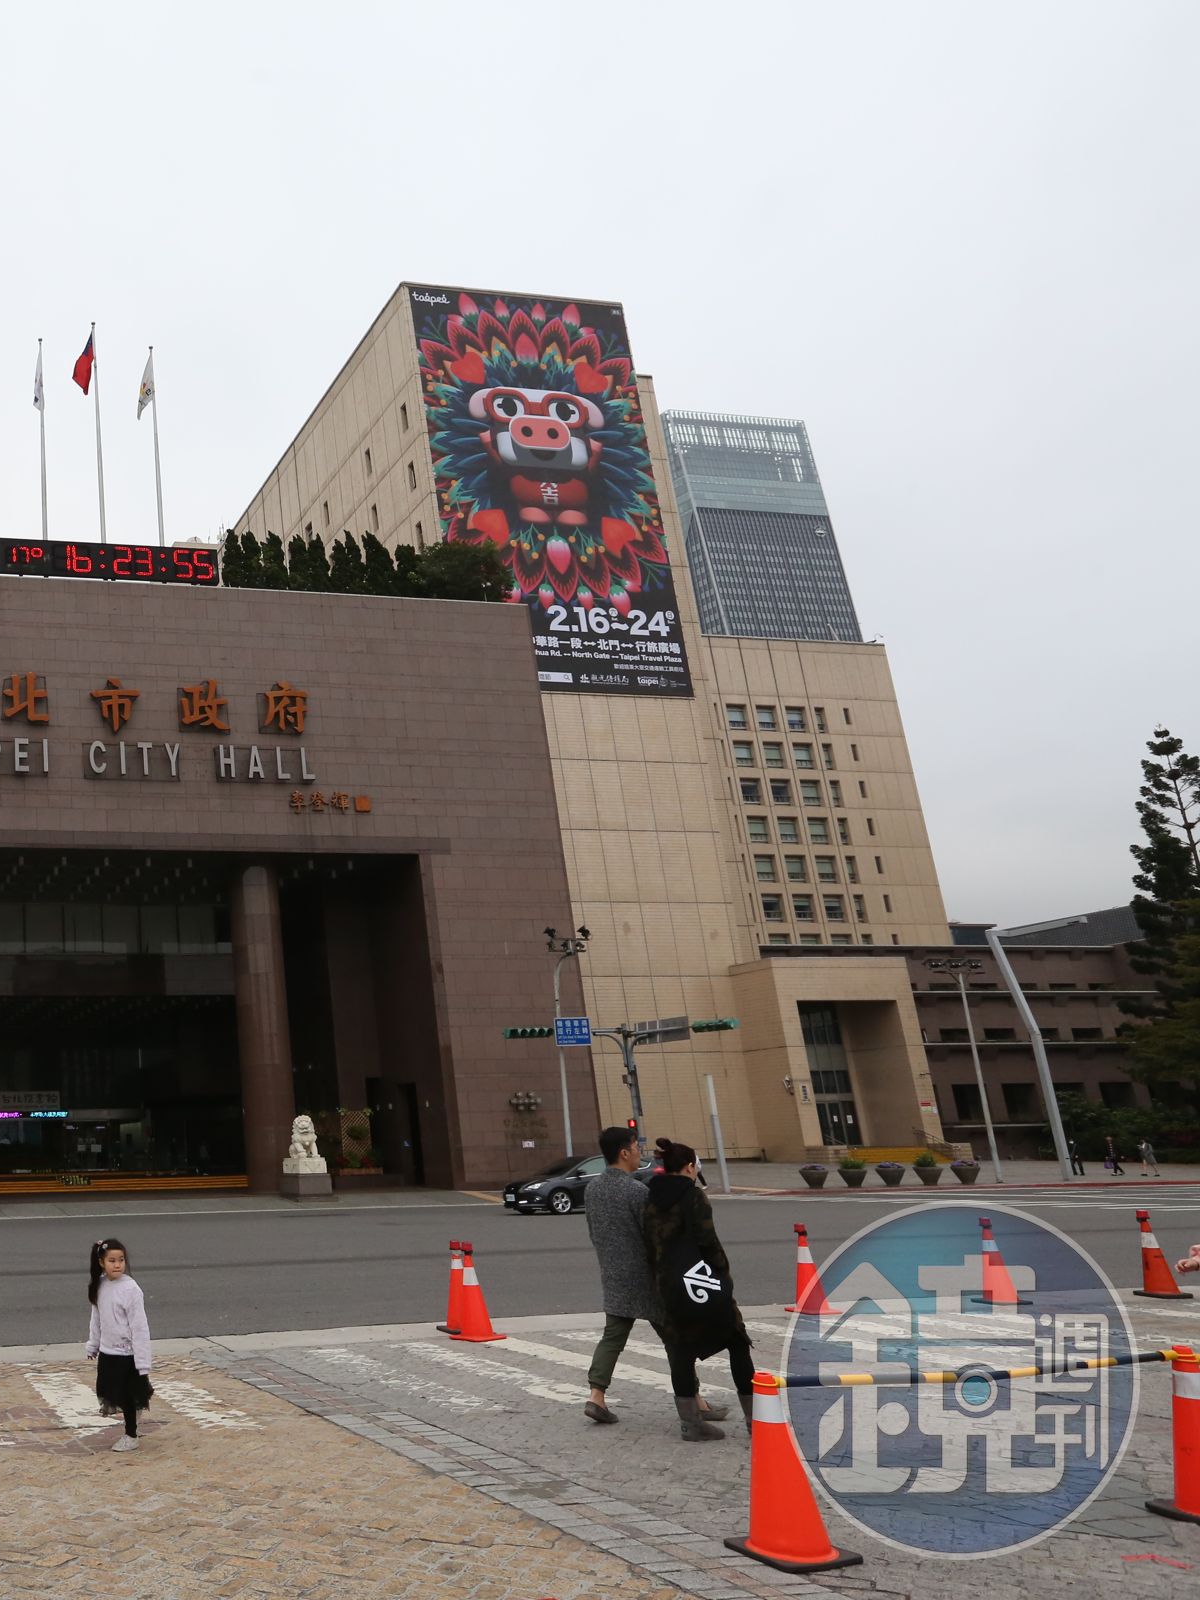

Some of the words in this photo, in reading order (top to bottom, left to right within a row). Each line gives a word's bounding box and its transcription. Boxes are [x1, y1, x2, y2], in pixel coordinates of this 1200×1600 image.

[572, 651, 593, 659] North
[594, 652, 610, 660] Gate
[619, 653, 640, 662] Taipei
[641, 654, 663, 662] Travel
[664, 655, 682, 663] Plaza
[89, 741, 180, 777] CITY
[219, 744, 316, 780] HALL
